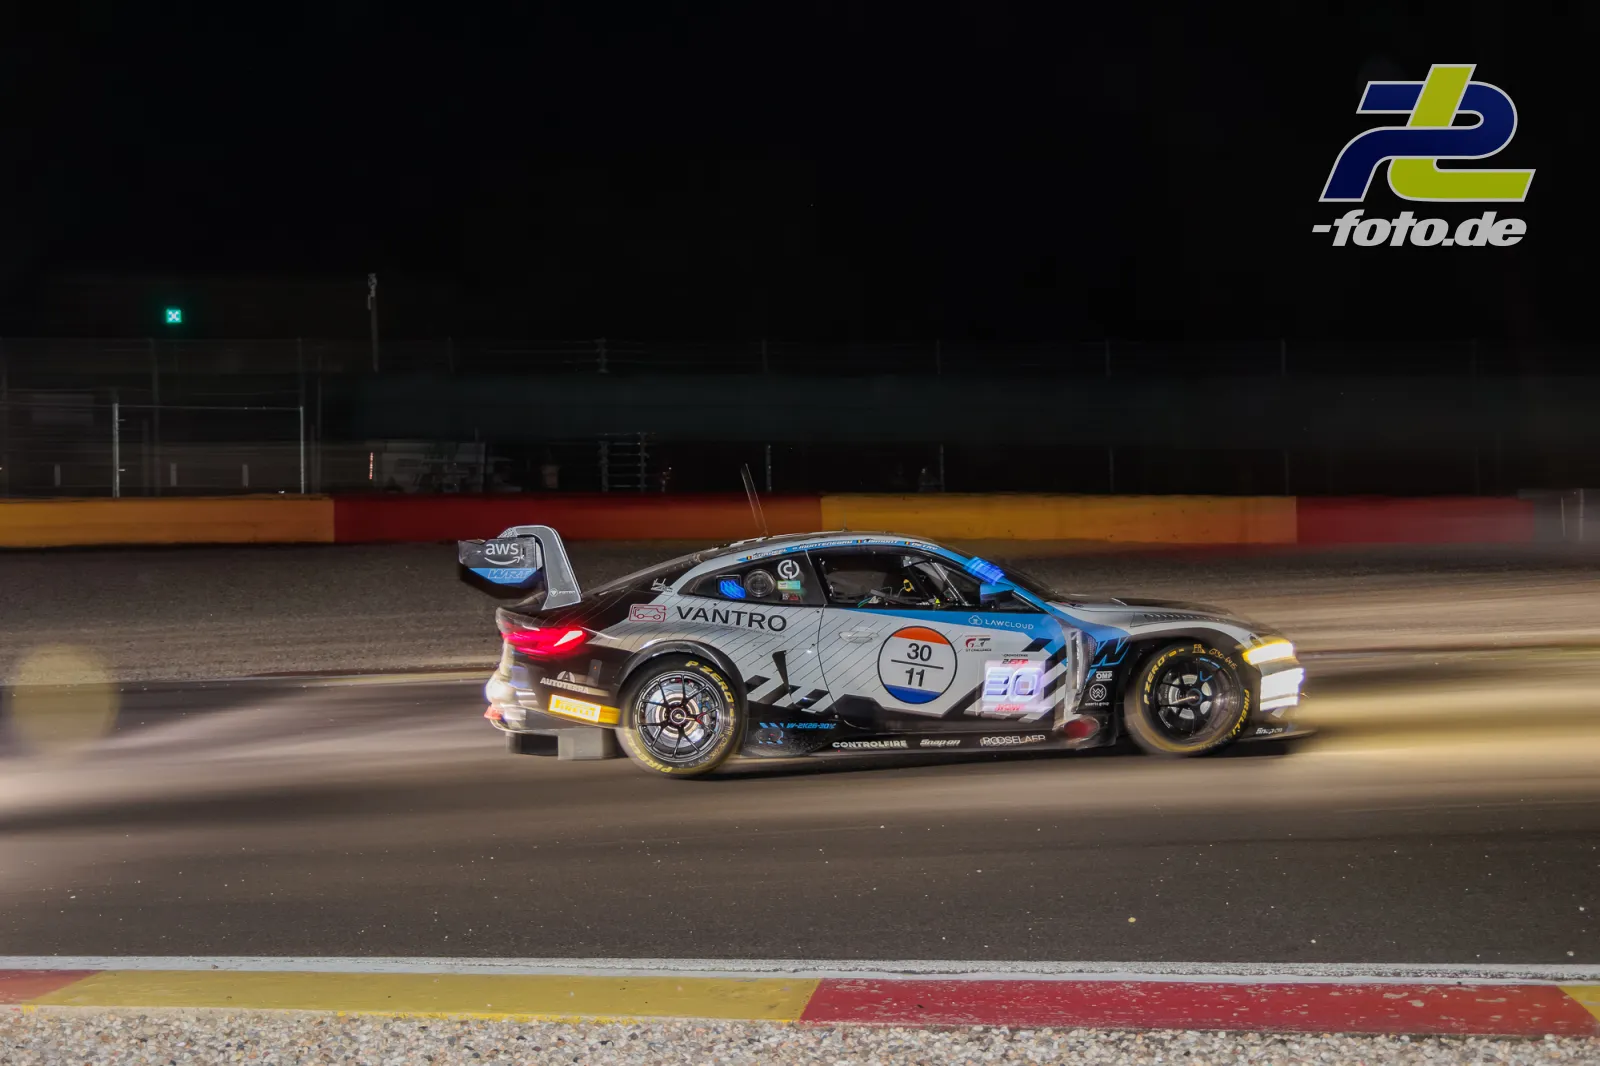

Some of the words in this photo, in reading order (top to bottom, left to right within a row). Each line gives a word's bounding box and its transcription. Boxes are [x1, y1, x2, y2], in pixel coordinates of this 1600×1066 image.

[485, 542, 519, 555] aws
[488, 568, 532, 579] WRT
[676, 605, 787, 632] VANTRO
[985, 619, 1034, 630] LAWCLOUD
[906, 642, 932, 662] 30
[699, 665, 735, 703] ZERO
[905, 667, 925, 687] 11
[1144, 655, 1165, 693] ZERO
[540, 677, 589, 694] AUTOTERRA
[982, 666, 1044, 703] 30
[1232, 688, 1251, 736] PIRELLI
[832, 739, 908, 749] CONTROLFIRE
